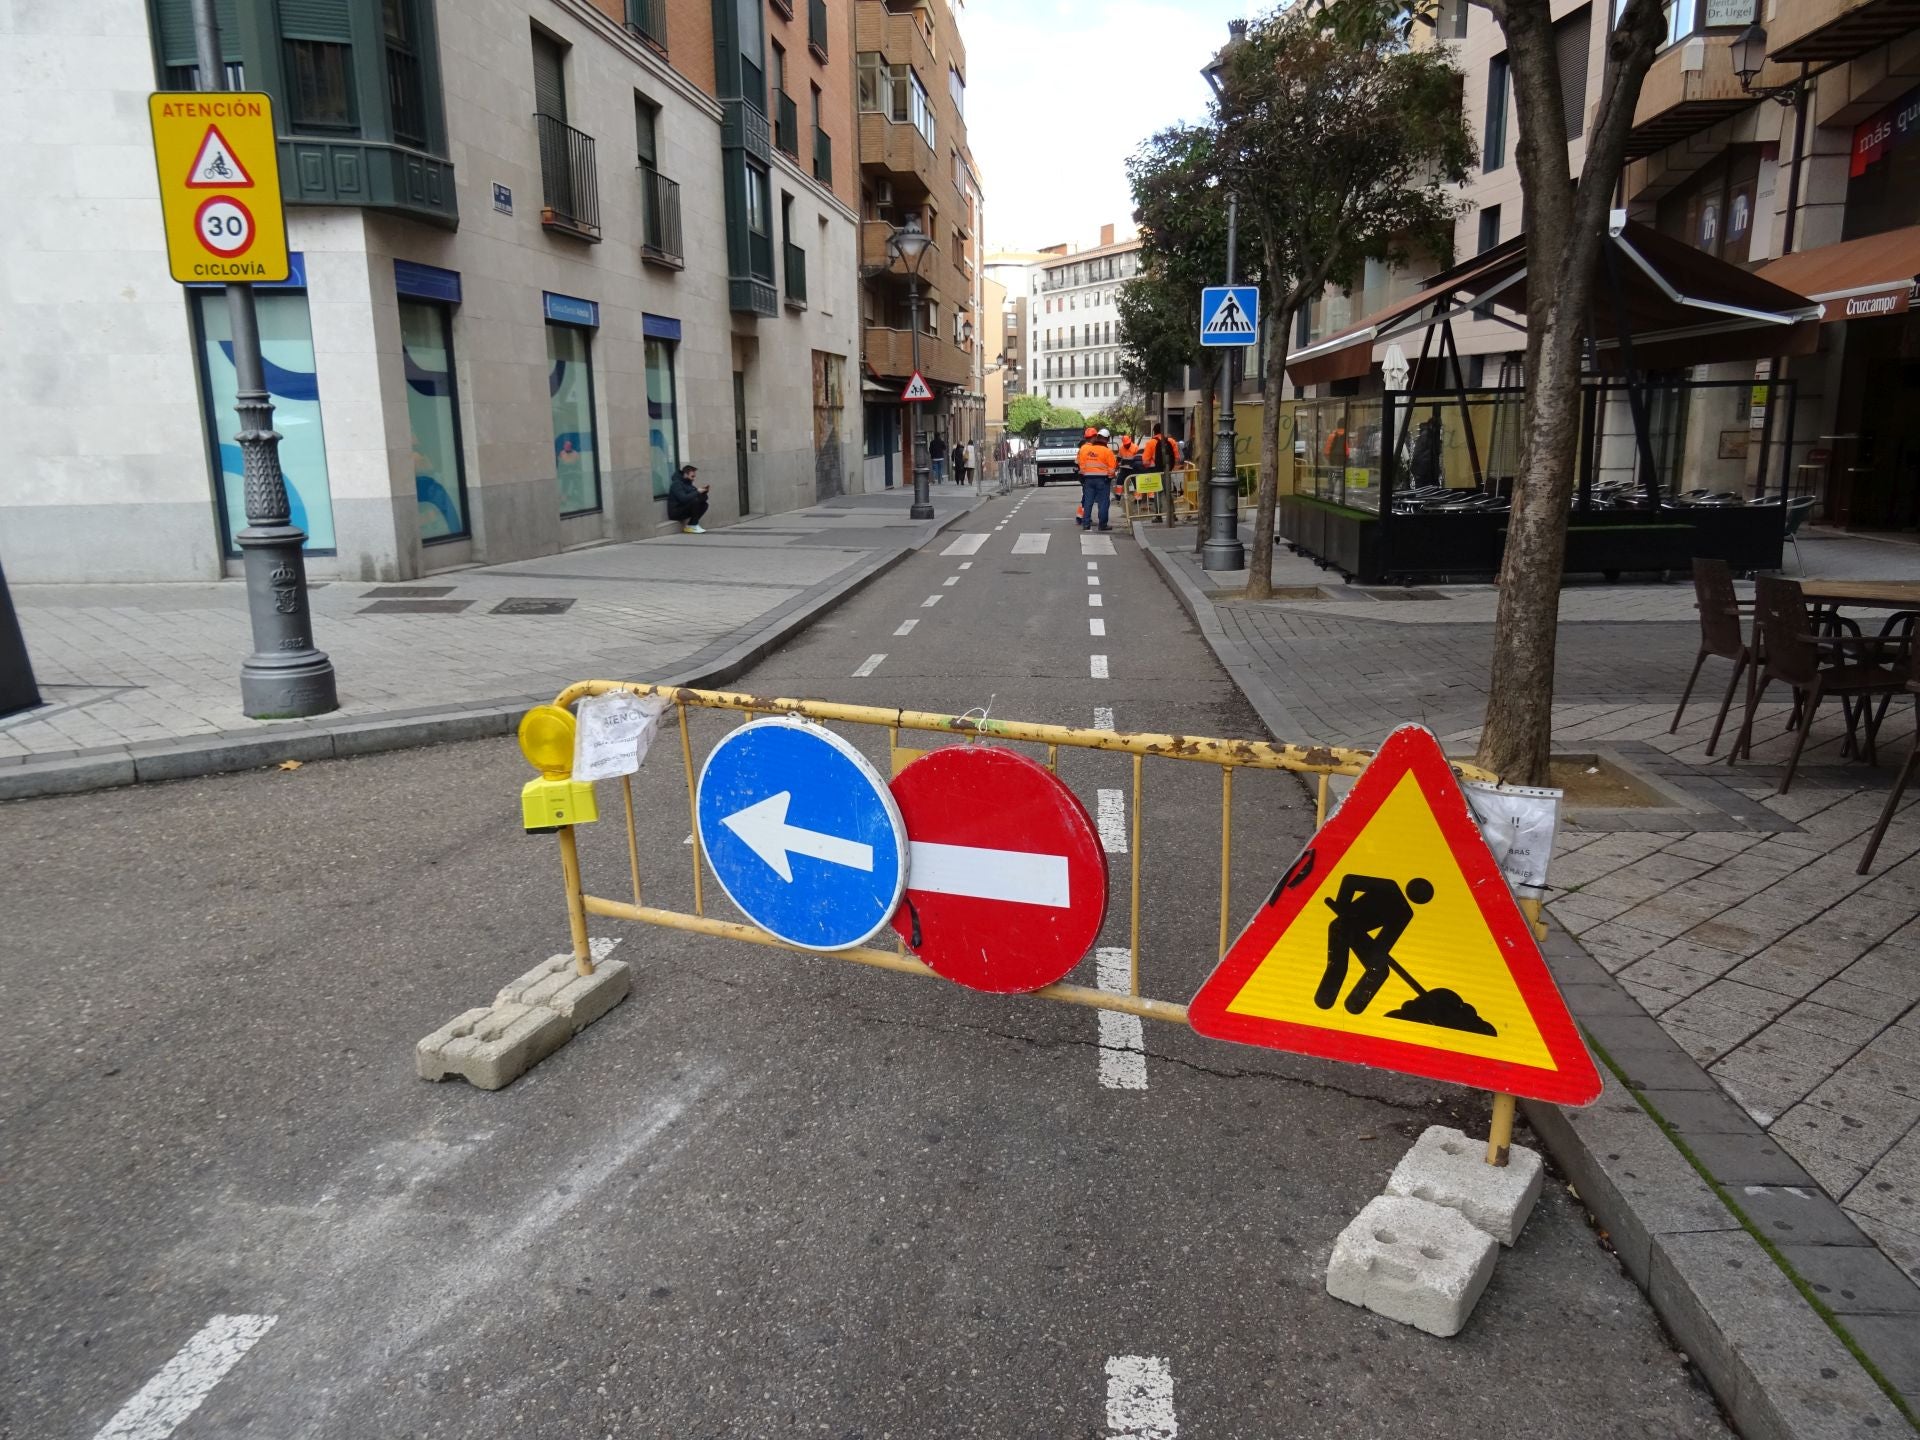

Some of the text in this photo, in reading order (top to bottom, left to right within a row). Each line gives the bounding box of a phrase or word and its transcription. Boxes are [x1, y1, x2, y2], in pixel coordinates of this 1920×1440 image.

[1708, 7, 1752, 19] Dr. Urgel
[163, 99, 261, 117] ATENCIÓN
[1859, 103, 1920, 154] más qu
[208, 216, 242, 237] 30
[194, 261, 266, 276] CICLOVÍA
[1846, 296, 1896, 315] Cruzcampo
